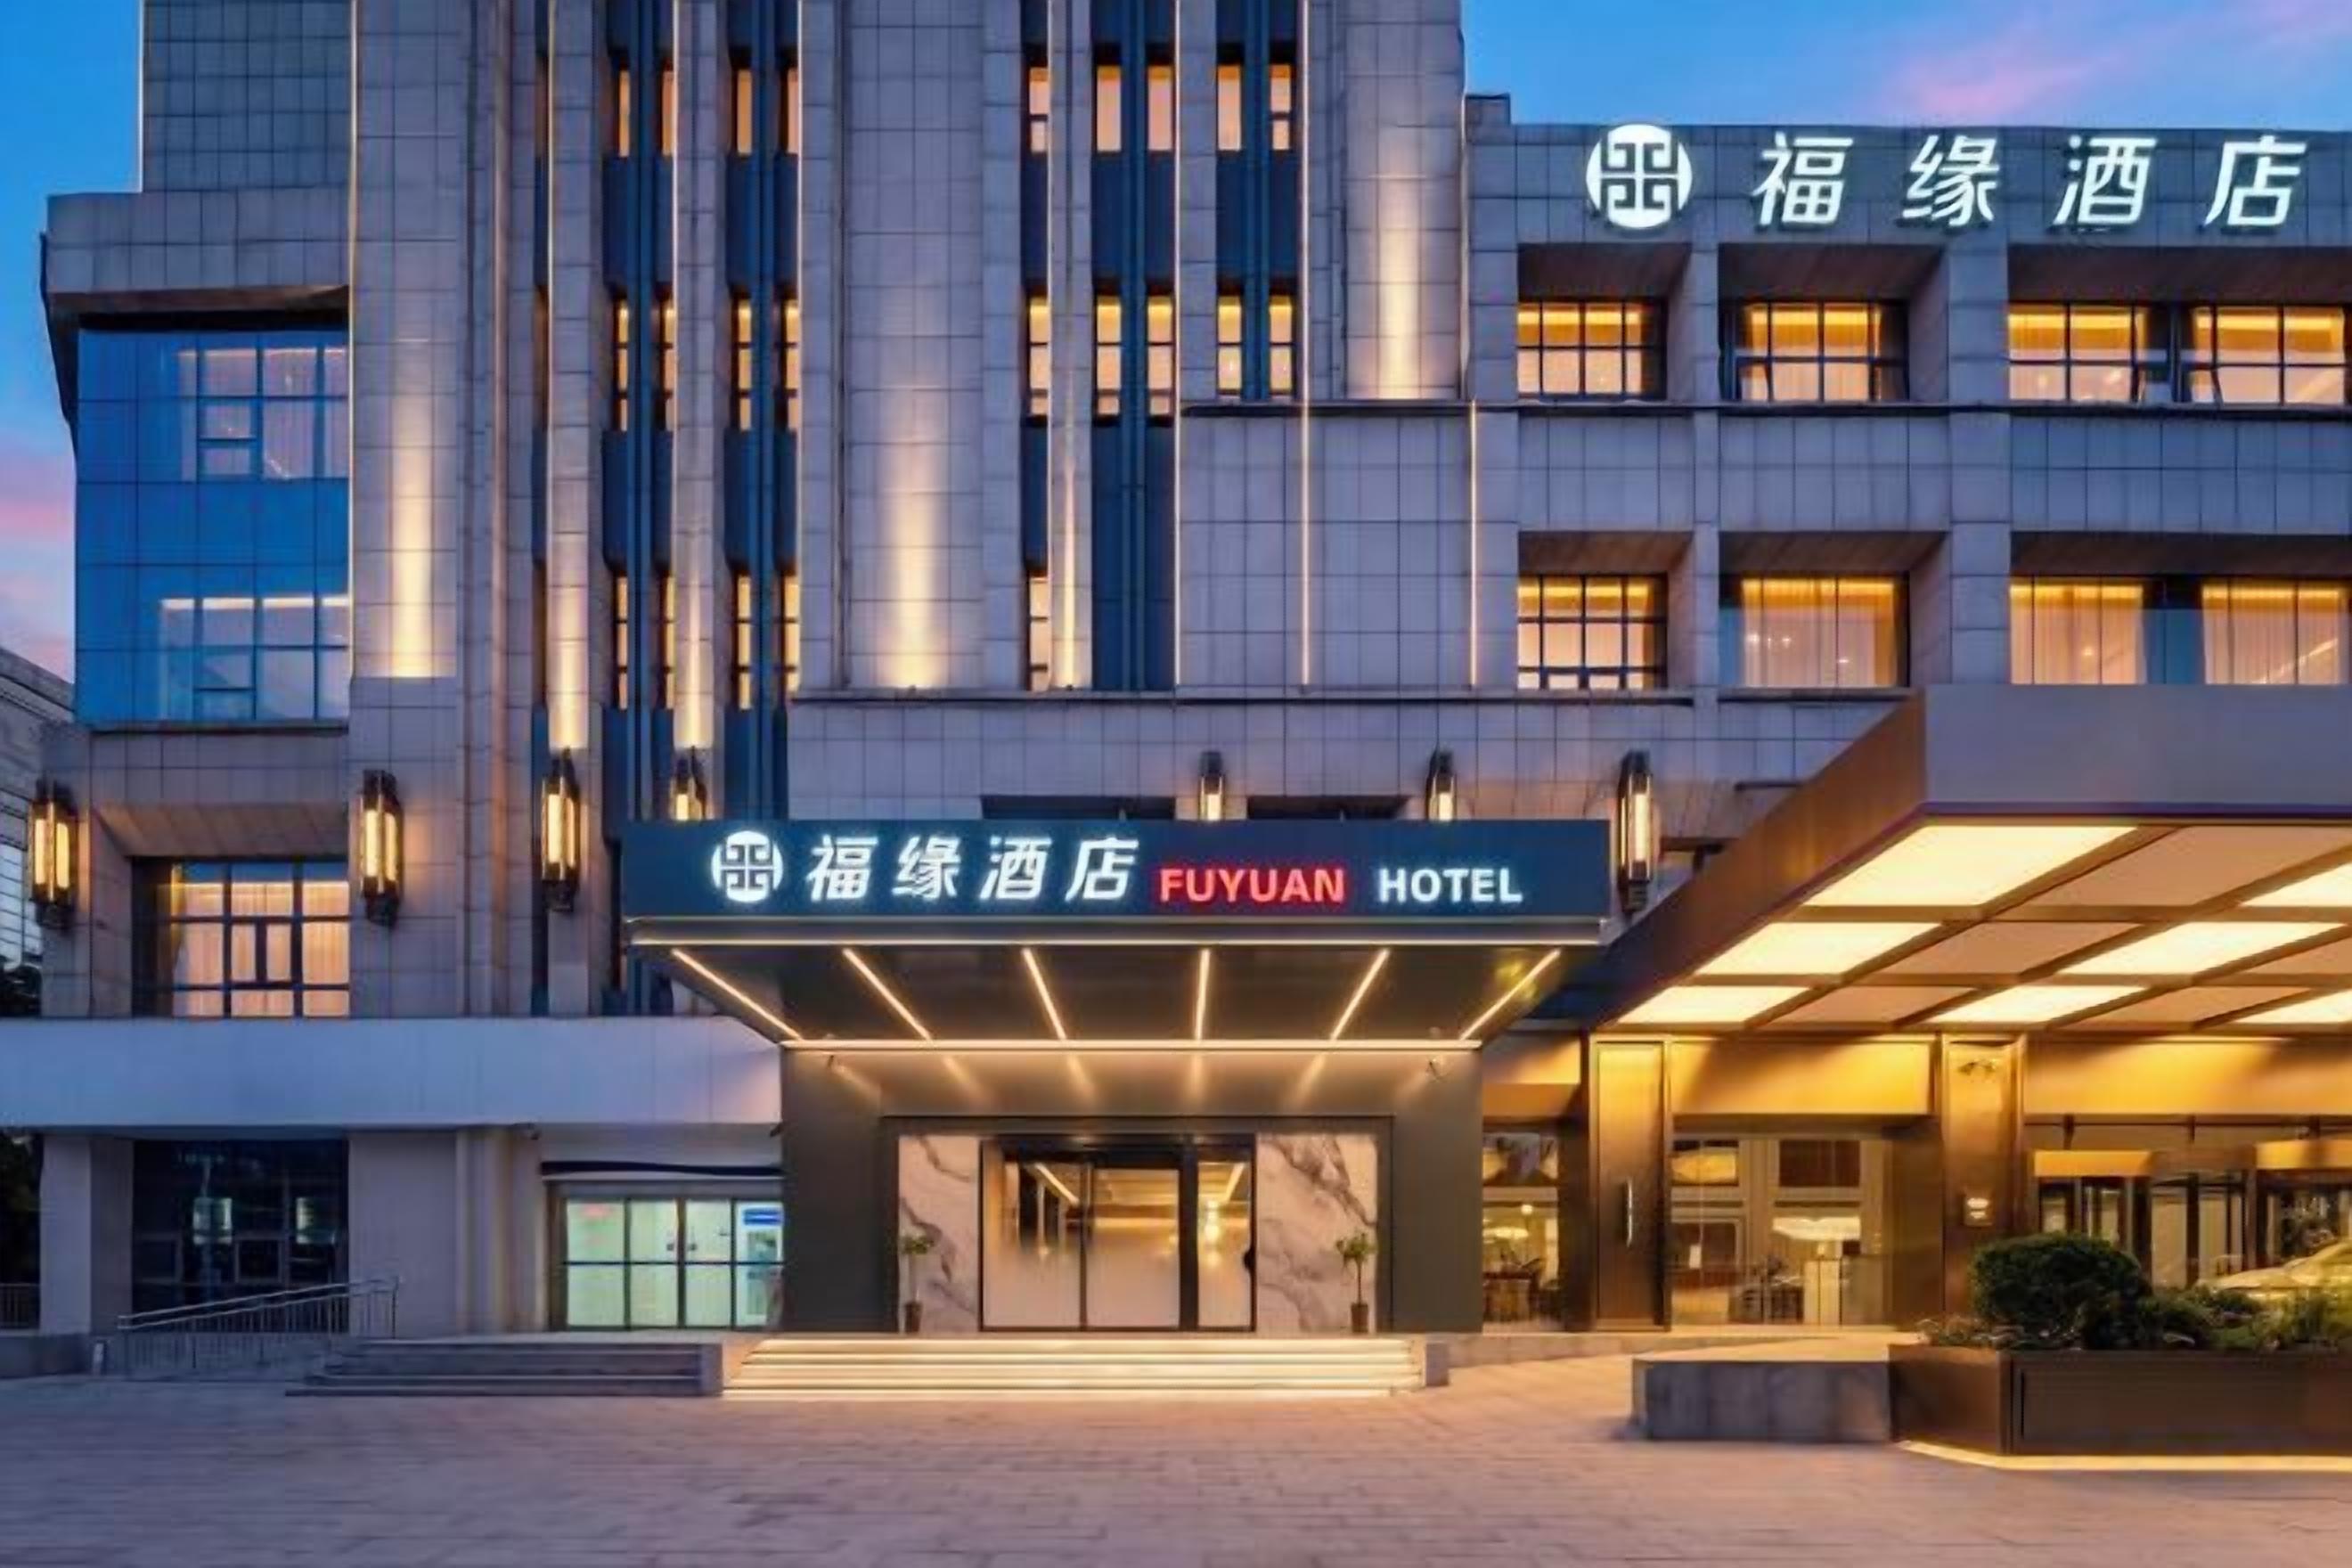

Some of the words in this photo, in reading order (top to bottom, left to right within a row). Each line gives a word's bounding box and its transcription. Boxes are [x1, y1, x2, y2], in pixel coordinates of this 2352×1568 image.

[1754, 131, 2307, 228] 福缘酒店
[805, 834, 1140, 902] 福缘酒店
[1159, 867, 1345, 902] FUYUAN
[1377, 867, 1523, 902] HOTEL
